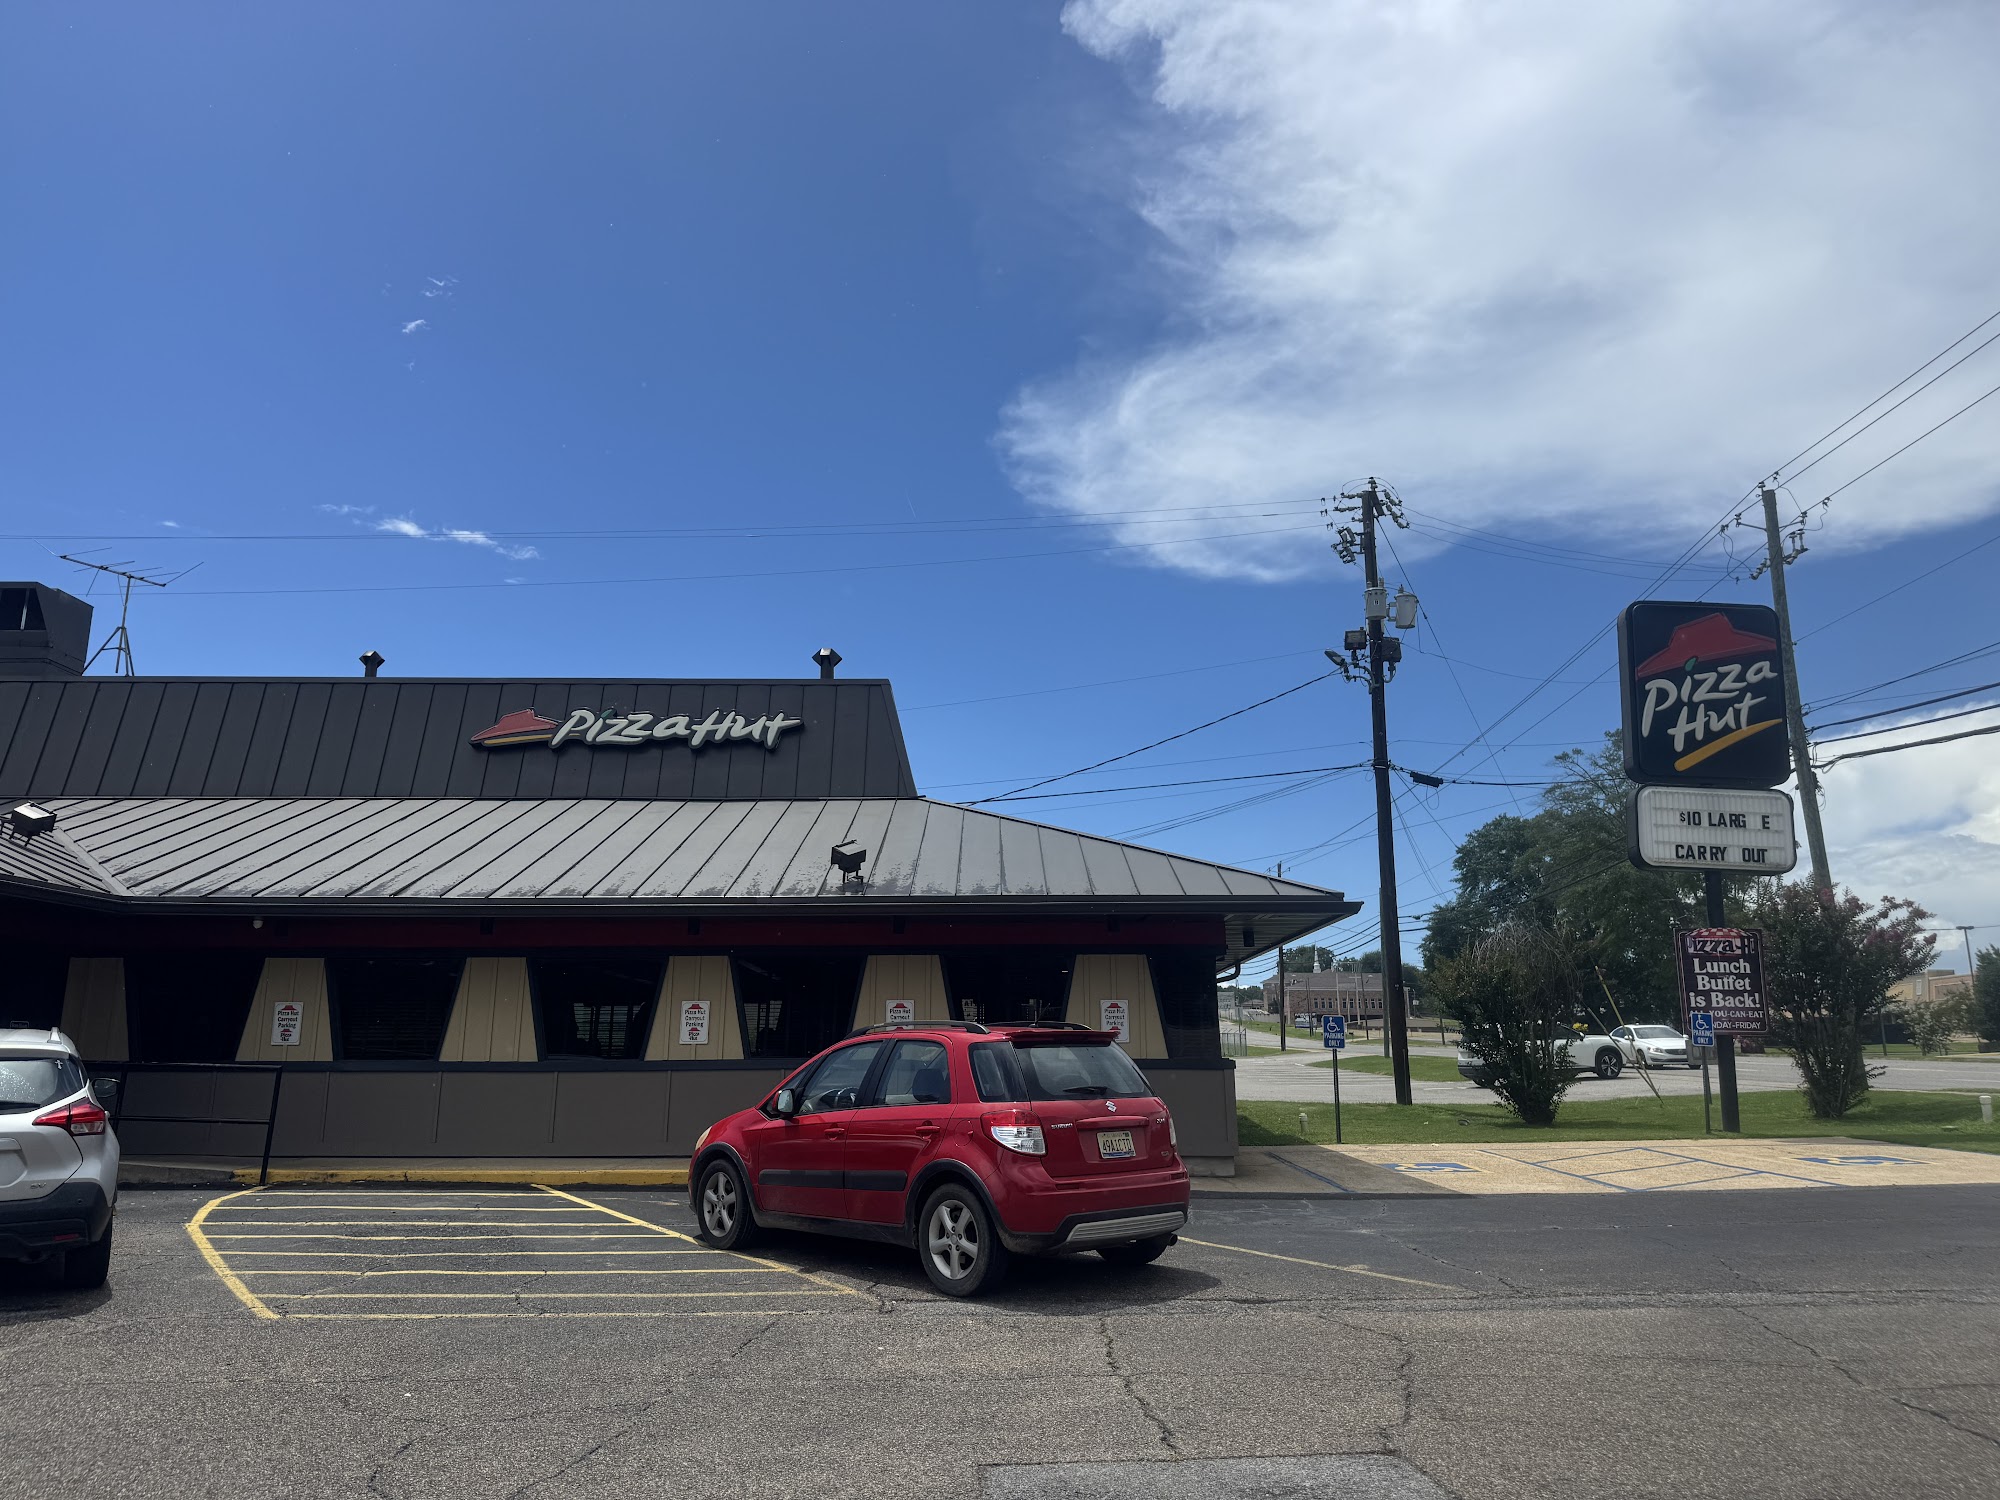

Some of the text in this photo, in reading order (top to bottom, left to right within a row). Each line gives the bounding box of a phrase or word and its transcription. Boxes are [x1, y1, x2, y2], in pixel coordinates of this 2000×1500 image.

[1642, 657, 1778, 738] Pizza
[551, 708, 801, 747] Pizza Hut
[1667, 692, 1767, 752] Hut
[1679, 811, 1702, 826] $10
[1675, 844, 1768, 863] CARRY OUT
[1693, 958, 1751, 974] Lunch
[1696, 975, 1752, 991] Buffet
[1689, 992, 1761, 1008] is Back!
[1712, 1021, 1761, 1029] NDAY-FRIDAY
